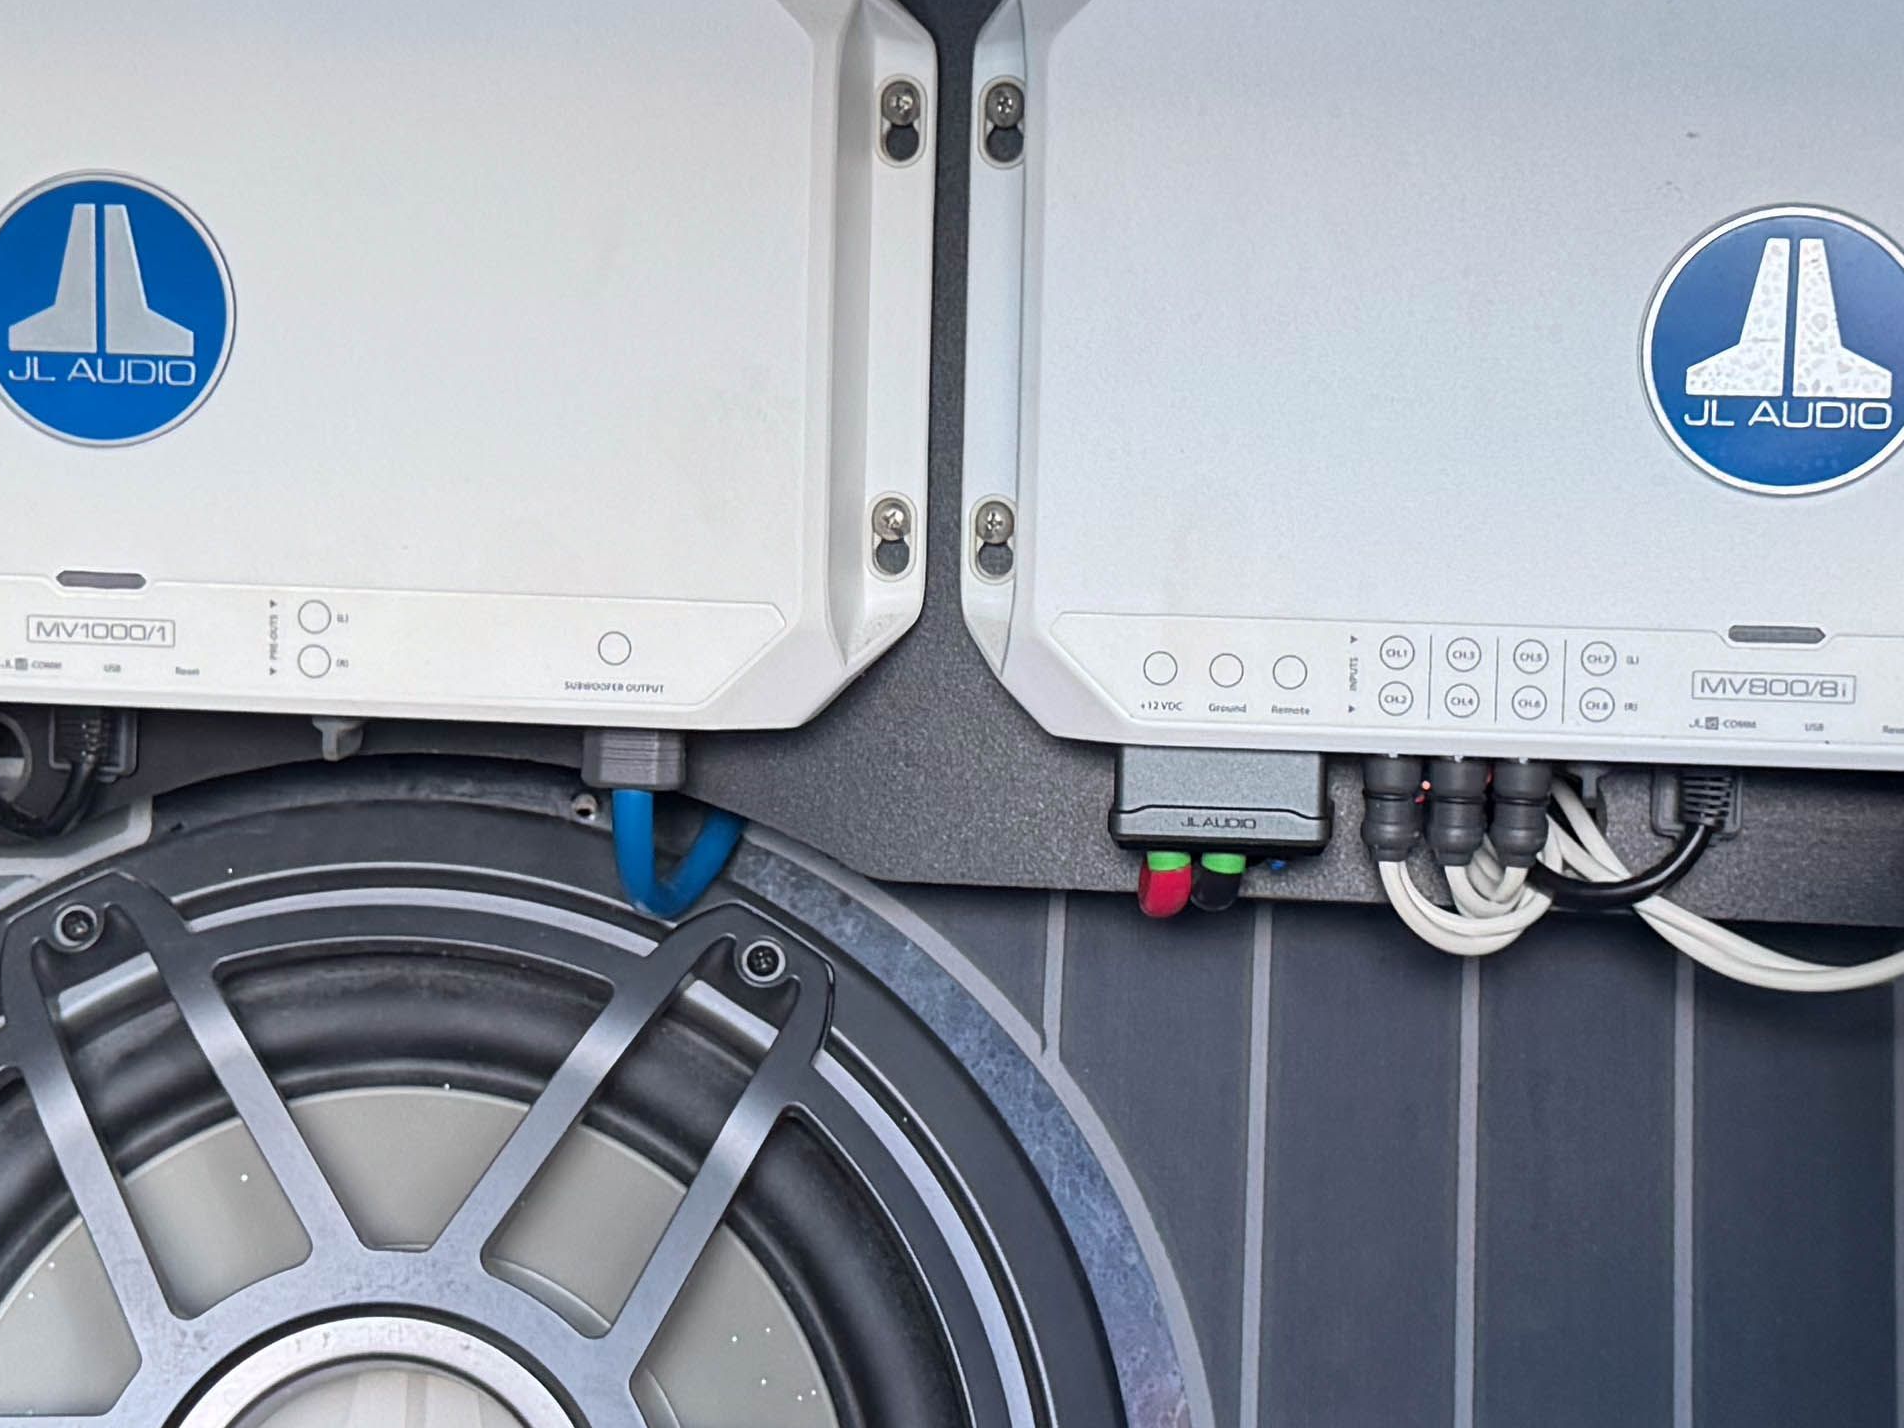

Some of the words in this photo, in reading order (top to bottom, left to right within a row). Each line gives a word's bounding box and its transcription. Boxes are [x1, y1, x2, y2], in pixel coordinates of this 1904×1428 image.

[8, 356, 56, 382] JL
[67, 357, 196, 386] AUDIO
[1684, 399, 1735, 427] JL
[1748, 400, 1892, 430] AUDIO
[35, 621, 167, 642] MV1000/1
[564, 680, 624, 692] SUBWOOFER
[626, 683, 665, 694] OUTPUT
[1700, 676, 1847, 698] MV800/8i
[1161, 702, 1184, 712] VDC
[1208, 703, 1247, 714] Ground
[1271, 704, 1311, 716] Remote
[1804, 722, 1825, 733] USB
[1180, 816, 1202, 829] JL
[1203, 816, 1257, 830] AUDIO
